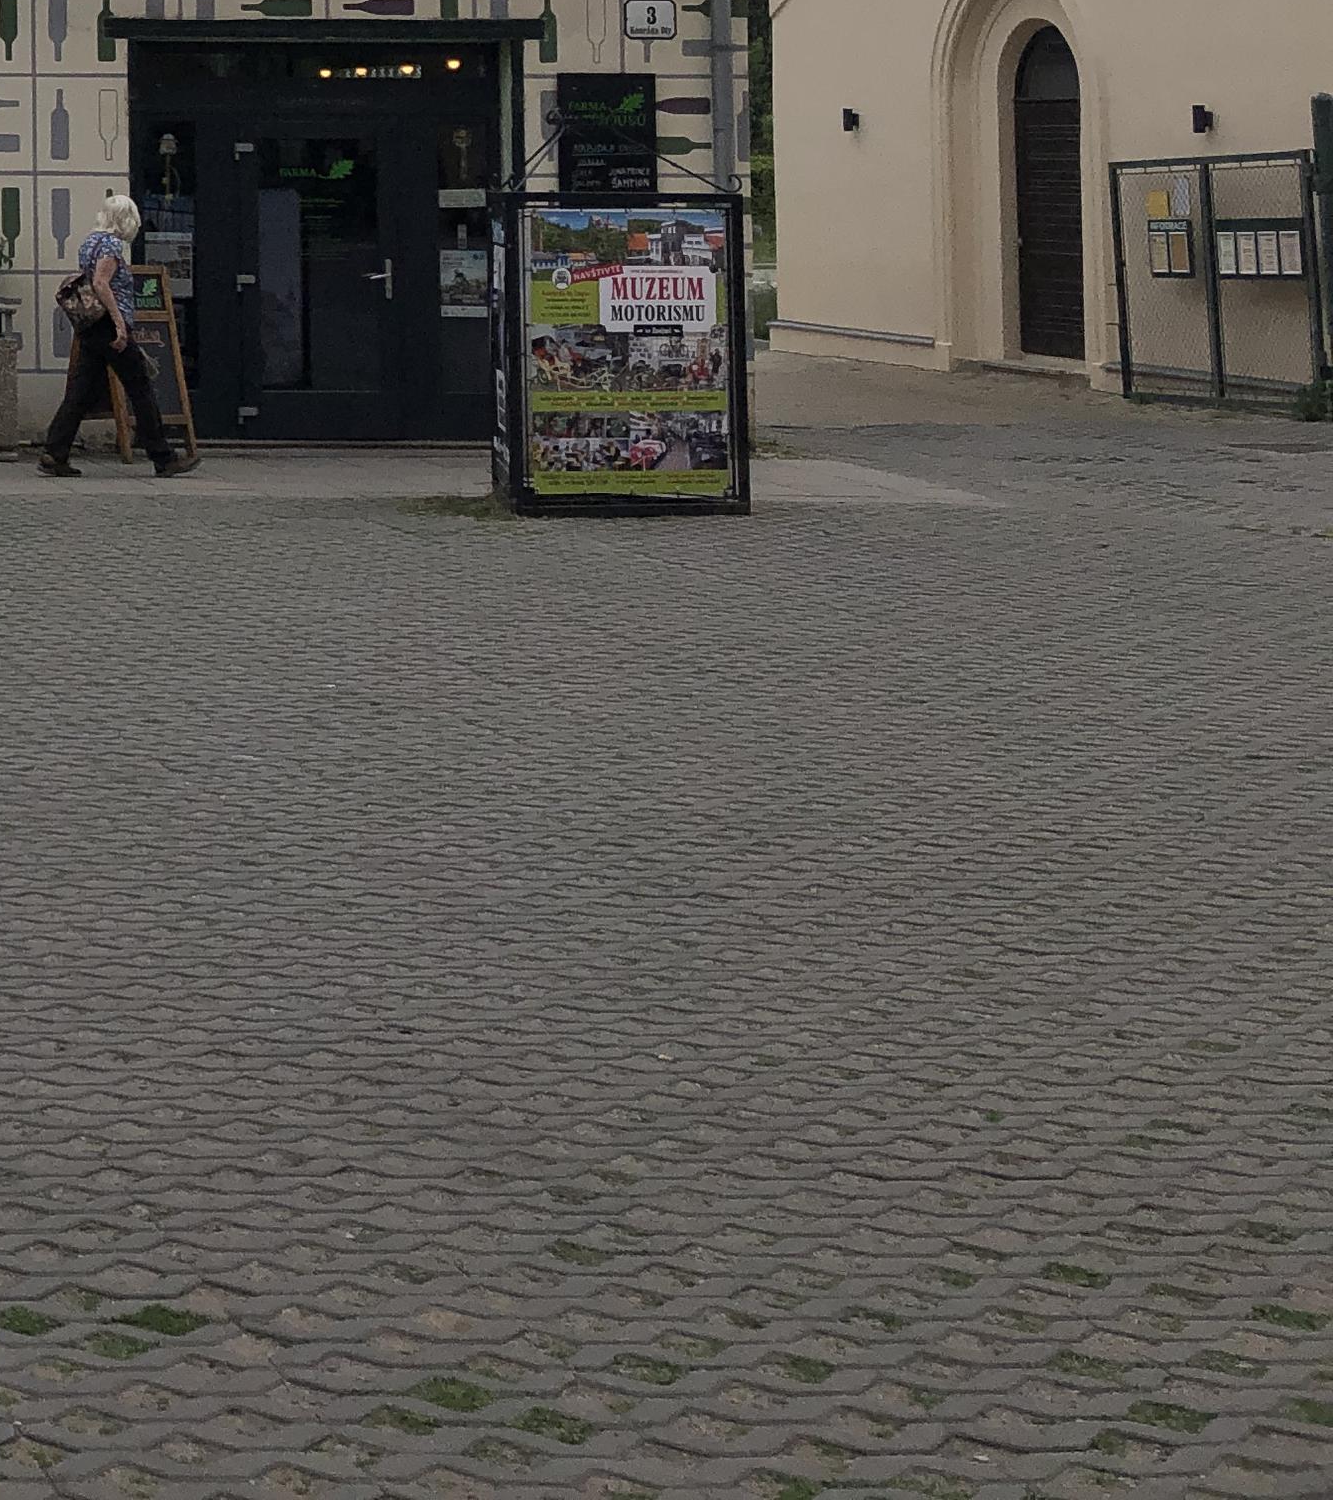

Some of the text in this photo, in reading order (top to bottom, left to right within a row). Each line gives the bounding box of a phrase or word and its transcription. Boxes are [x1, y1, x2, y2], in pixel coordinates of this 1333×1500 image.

[646, 6, 657, 25] 3
[573, 264, 623, 281] NAVŠTIVTE
[611, 276, 705, 301] MUZEUM
[611, 304, 705, 322] MOTORISMU
